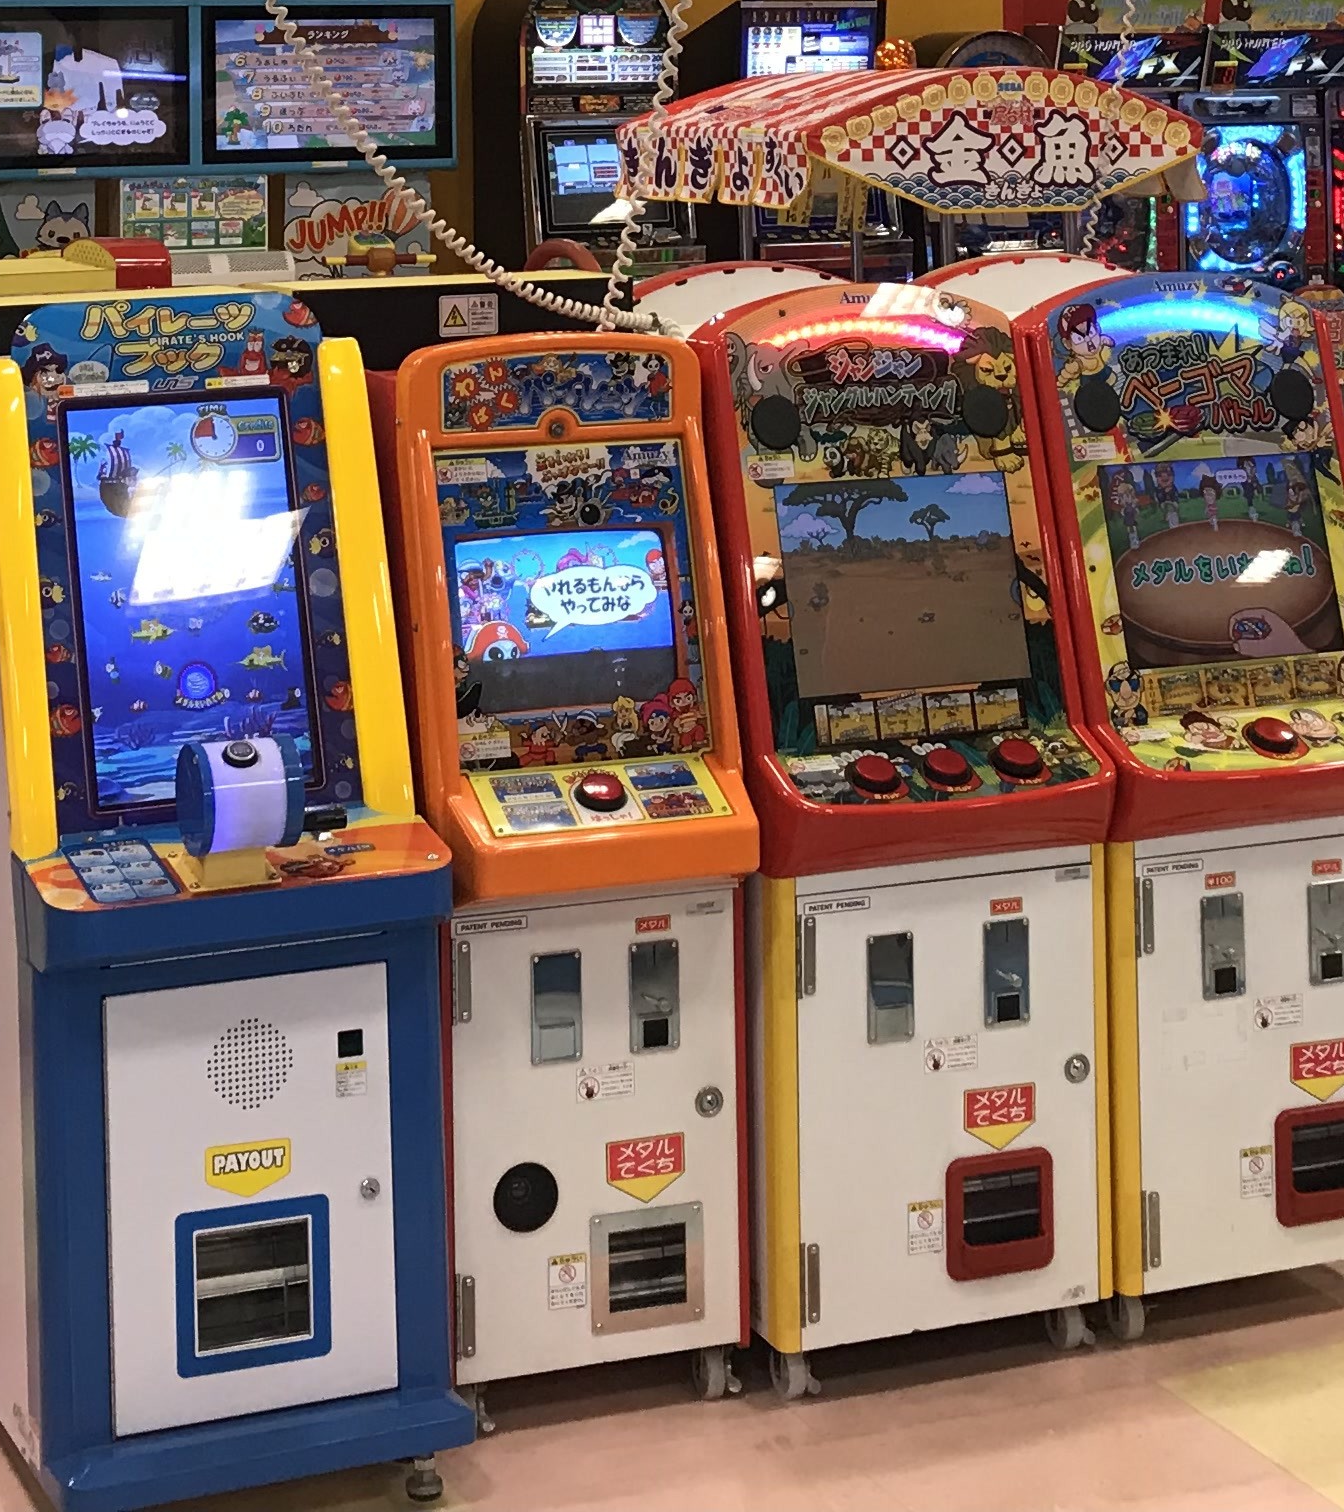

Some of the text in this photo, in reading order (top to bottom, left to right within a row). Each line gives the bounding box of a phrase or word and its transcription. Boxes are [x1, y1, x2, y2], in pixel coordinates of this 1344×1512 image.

[1137, 51, 1181, 79] FX
[1285, 49, 1330, 76] FX
[922, 110, 1096, 188] 金魚
[983, 182, 1044, 201] きんぎょ
[287, 199, 388, 252] JUMP!!
[1153, 280, 1202, 294] Amuzy
[80, 299, 254, 341] パイレーツ
[149, 331, 245, 347] PIRATE'S HOOK
[115, 342, 225, 376] フック
[828, 348, 923, 384] ジャンジャン
[1120, 334, 1208, 374] あつまれ!
[1119, 355, 1256, 411] ベーゴマ
[803, 378, 959, 423] ジャングルハンティング
[1209, 397, 1275, 428] バトル
[623, 447, 670, 463] Amuzy
[560, 595, 632, 615] やってみな
[1146, 860, 1201, 874] PATENT PENDING
[808, 898, 867, 913] PATENT PENDING
[993, 900, 1021, 913] メダル
[460, 917, 523, 932] PATENT PENDING
[639, 919, 668, 932] メダル
[973, 1088, 1026, 1109] メダル
[212, 1146, 286, 1176] PAYOUT
[617, 1136, 675, 1162] メダル
